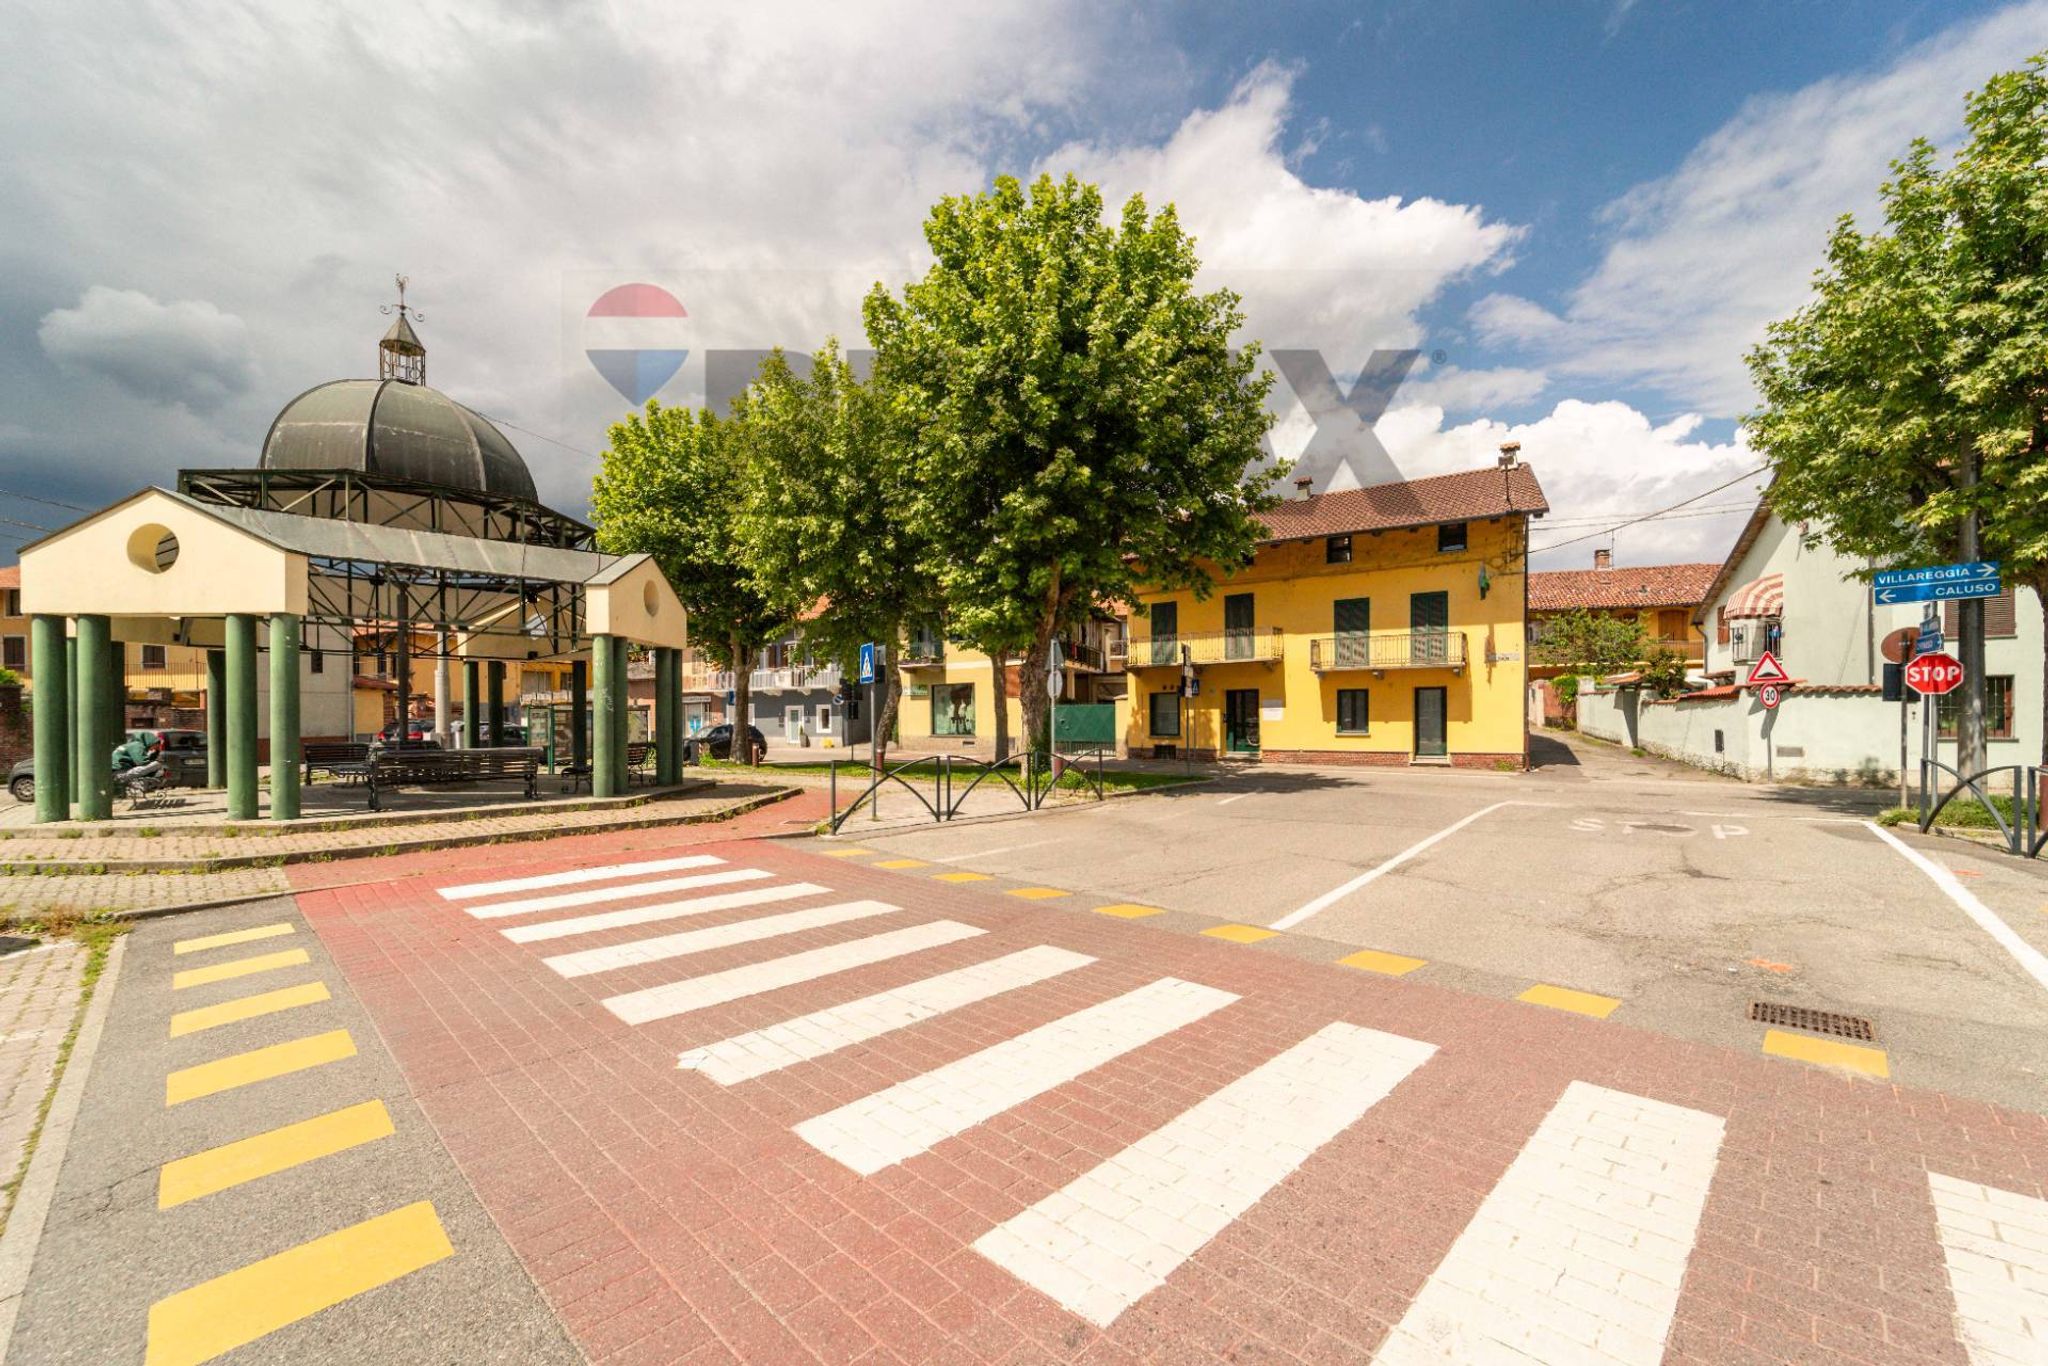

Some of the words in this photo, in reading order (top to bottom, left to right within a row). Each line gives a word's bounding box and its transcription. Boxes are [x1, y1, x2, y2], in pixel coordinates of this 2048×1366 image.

[1879, 568, 1970, 584] VILLAREGGIA
[1935, 583, 1996, 596] CALUSO
[1908, 667, 1960, 682] STOP
[1765, 689, 1775, 701] 30
